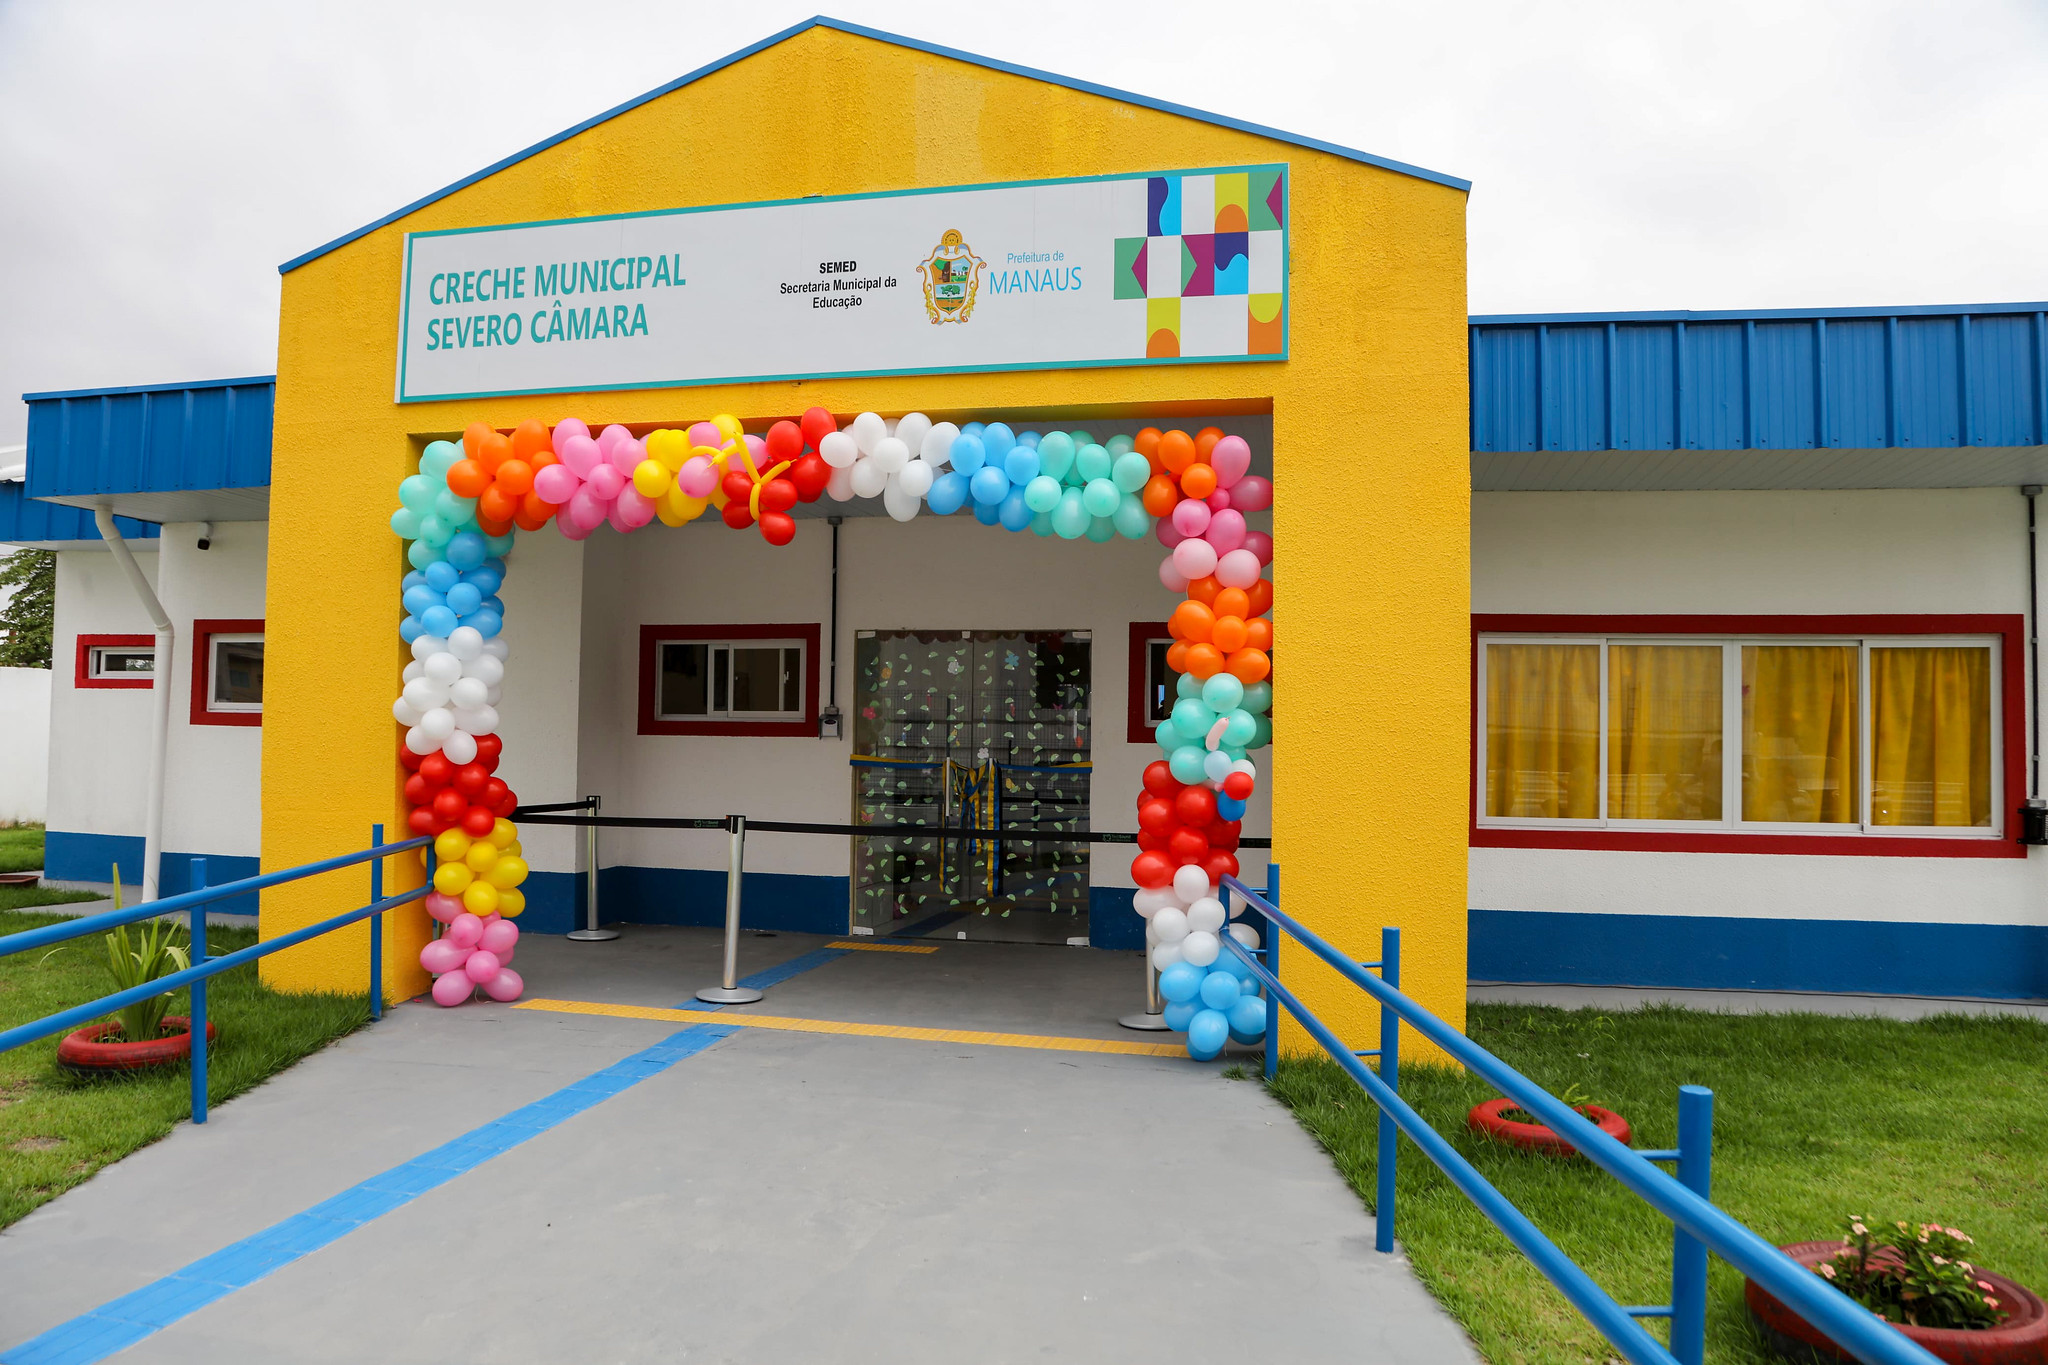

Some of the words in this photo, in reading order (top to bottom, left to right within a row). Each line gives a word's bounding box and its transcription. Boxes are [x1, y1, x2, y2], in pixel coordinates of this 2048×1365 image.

[819, 260, 858, 274] SEMED
[1007, 252, 1051, 264] Prefeitura
[1052, 250, 1065, 262] de
[429, 266, 526, 305] CRECHE
[534, 253, 687, 297] MUNICIPAL
[779, 280, 831, 295] Secretaria
[832, 276, 882, 292] Municipal
[883, 275, 898, 288] da
[989, 266, 1083, 295] MANAUS
[812, 294, 863, 310] Educação
[426, 312, 523, 351] SEVERO
[530, 299, 649, 344] CÂMARA
